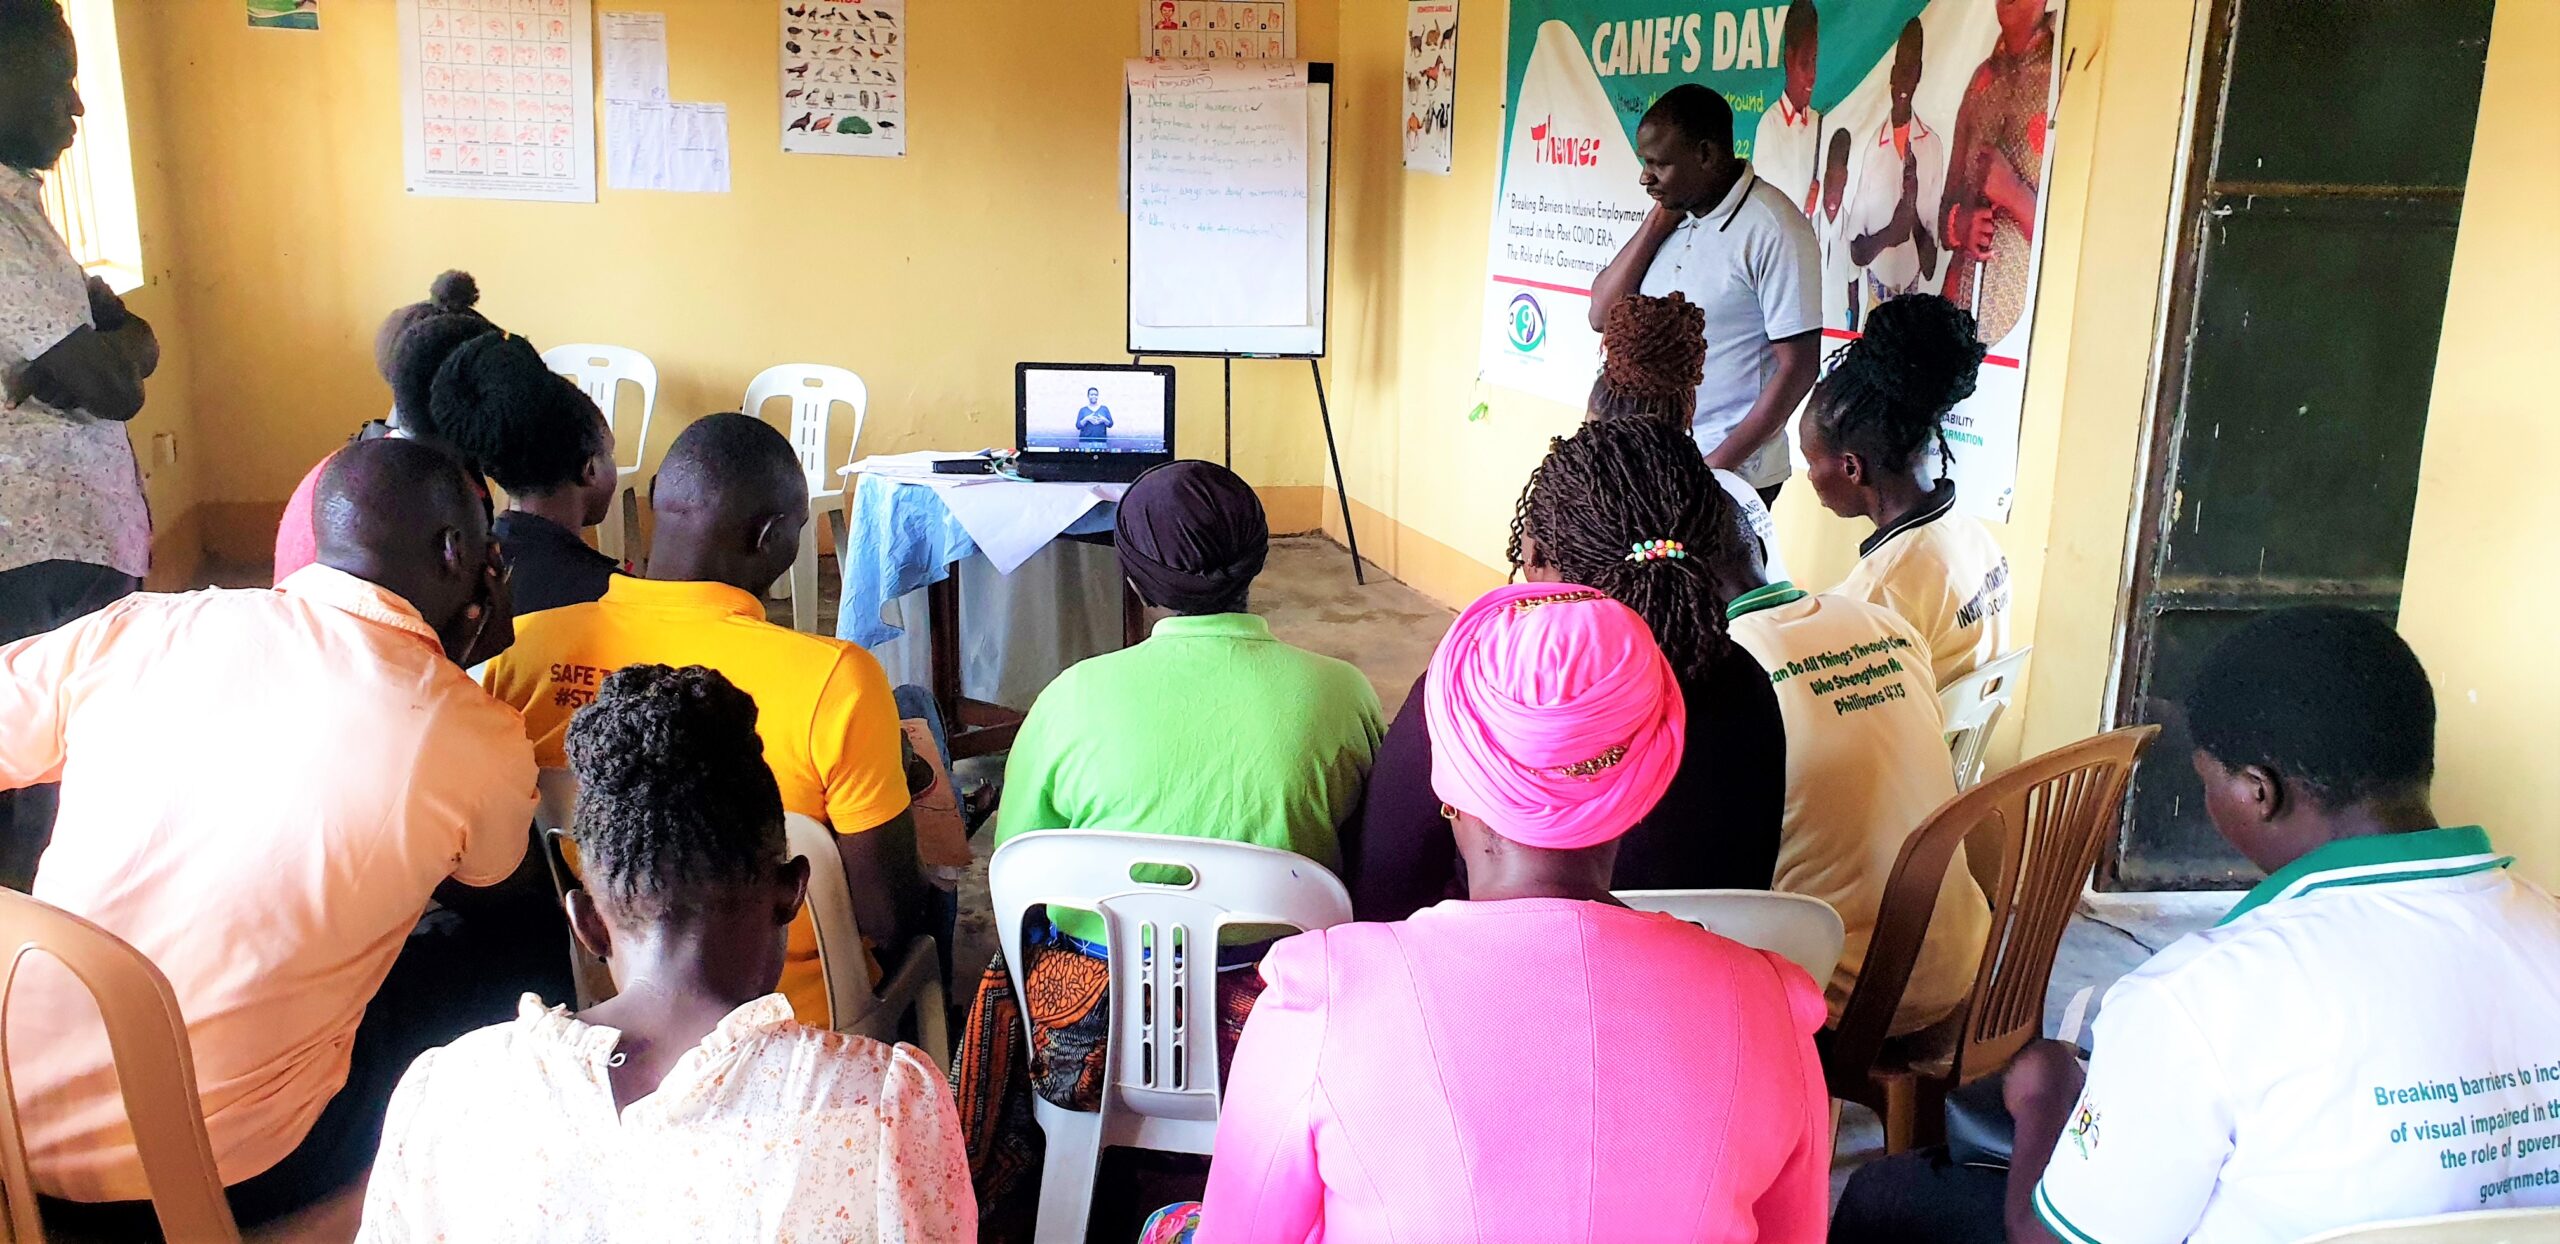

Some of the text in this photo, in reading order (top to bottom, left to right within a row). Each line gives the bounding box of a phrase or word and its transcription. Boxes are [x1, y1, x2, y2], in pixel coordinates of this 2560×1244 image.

[1234, 22, 1241, 30] C
[1155, 49, 1160, 57] E
[1208, 50, 1216, 58] G
[1592, 5, 1790, 77] CANE'S DAY
[1724, 89, 1764, 112] round
[1530, 114, 1600, 167] Theme:
[1539, 195, 1563, 214] Barriers
[1565, 202, 1571, 215] to
[1597, 200, 1645, 224] Employment
[1509, 218, 1535, 238] Impaired
[1536, 224, 1543, 238] in
[1545, 222, 1555, 239] the
[1557, 223, 1571, 241] Post
[1572, 225, 1595, 245] COVID
[1507, 243, 1518, 261] The
[1520, 245, 1533, 263] Role
[1535, 248, 1543, 264] of
[1544, 249, 1555, 266] the
[1557, 250, 1594, 272] Government
[1943, 428, 1983, 447] ORMATION
[550, 663, 596, 686] SAFE
[1772, 668, 1790, 684] an
[1786, 661, 1804, 676] Do
[1803, 656, 1821, 672] All
[1816, 650, 1854, 669] Things
[1850, 636, 1890, 659] Through
[1809, 678, 1835, 696] Who
[1832, 663, 1891, 689] Strengthen
[1883, 682, 1906, 701] 4:13
[555, 688, 594, 709] #ST
[2374, 1080, 2459, 1106] Breaking
[2459, 1071, 2516, 1096] barriers
[2517, 1067, 2531, 1086] to
[2390, 1121, 2407, 1144] of
[2413, 1116, 2467, 1141] visual
[2471, 1104, 2529, 1136] impaired
[2532, 1102, 2546, 1122] in
[2440, 1149, 2467, 1169] the
[2471, 1143, 2498, 1164] role
[2501, 1136, 2512, 1158] of
[2480, 1165, 2560, 1203] governmeta
